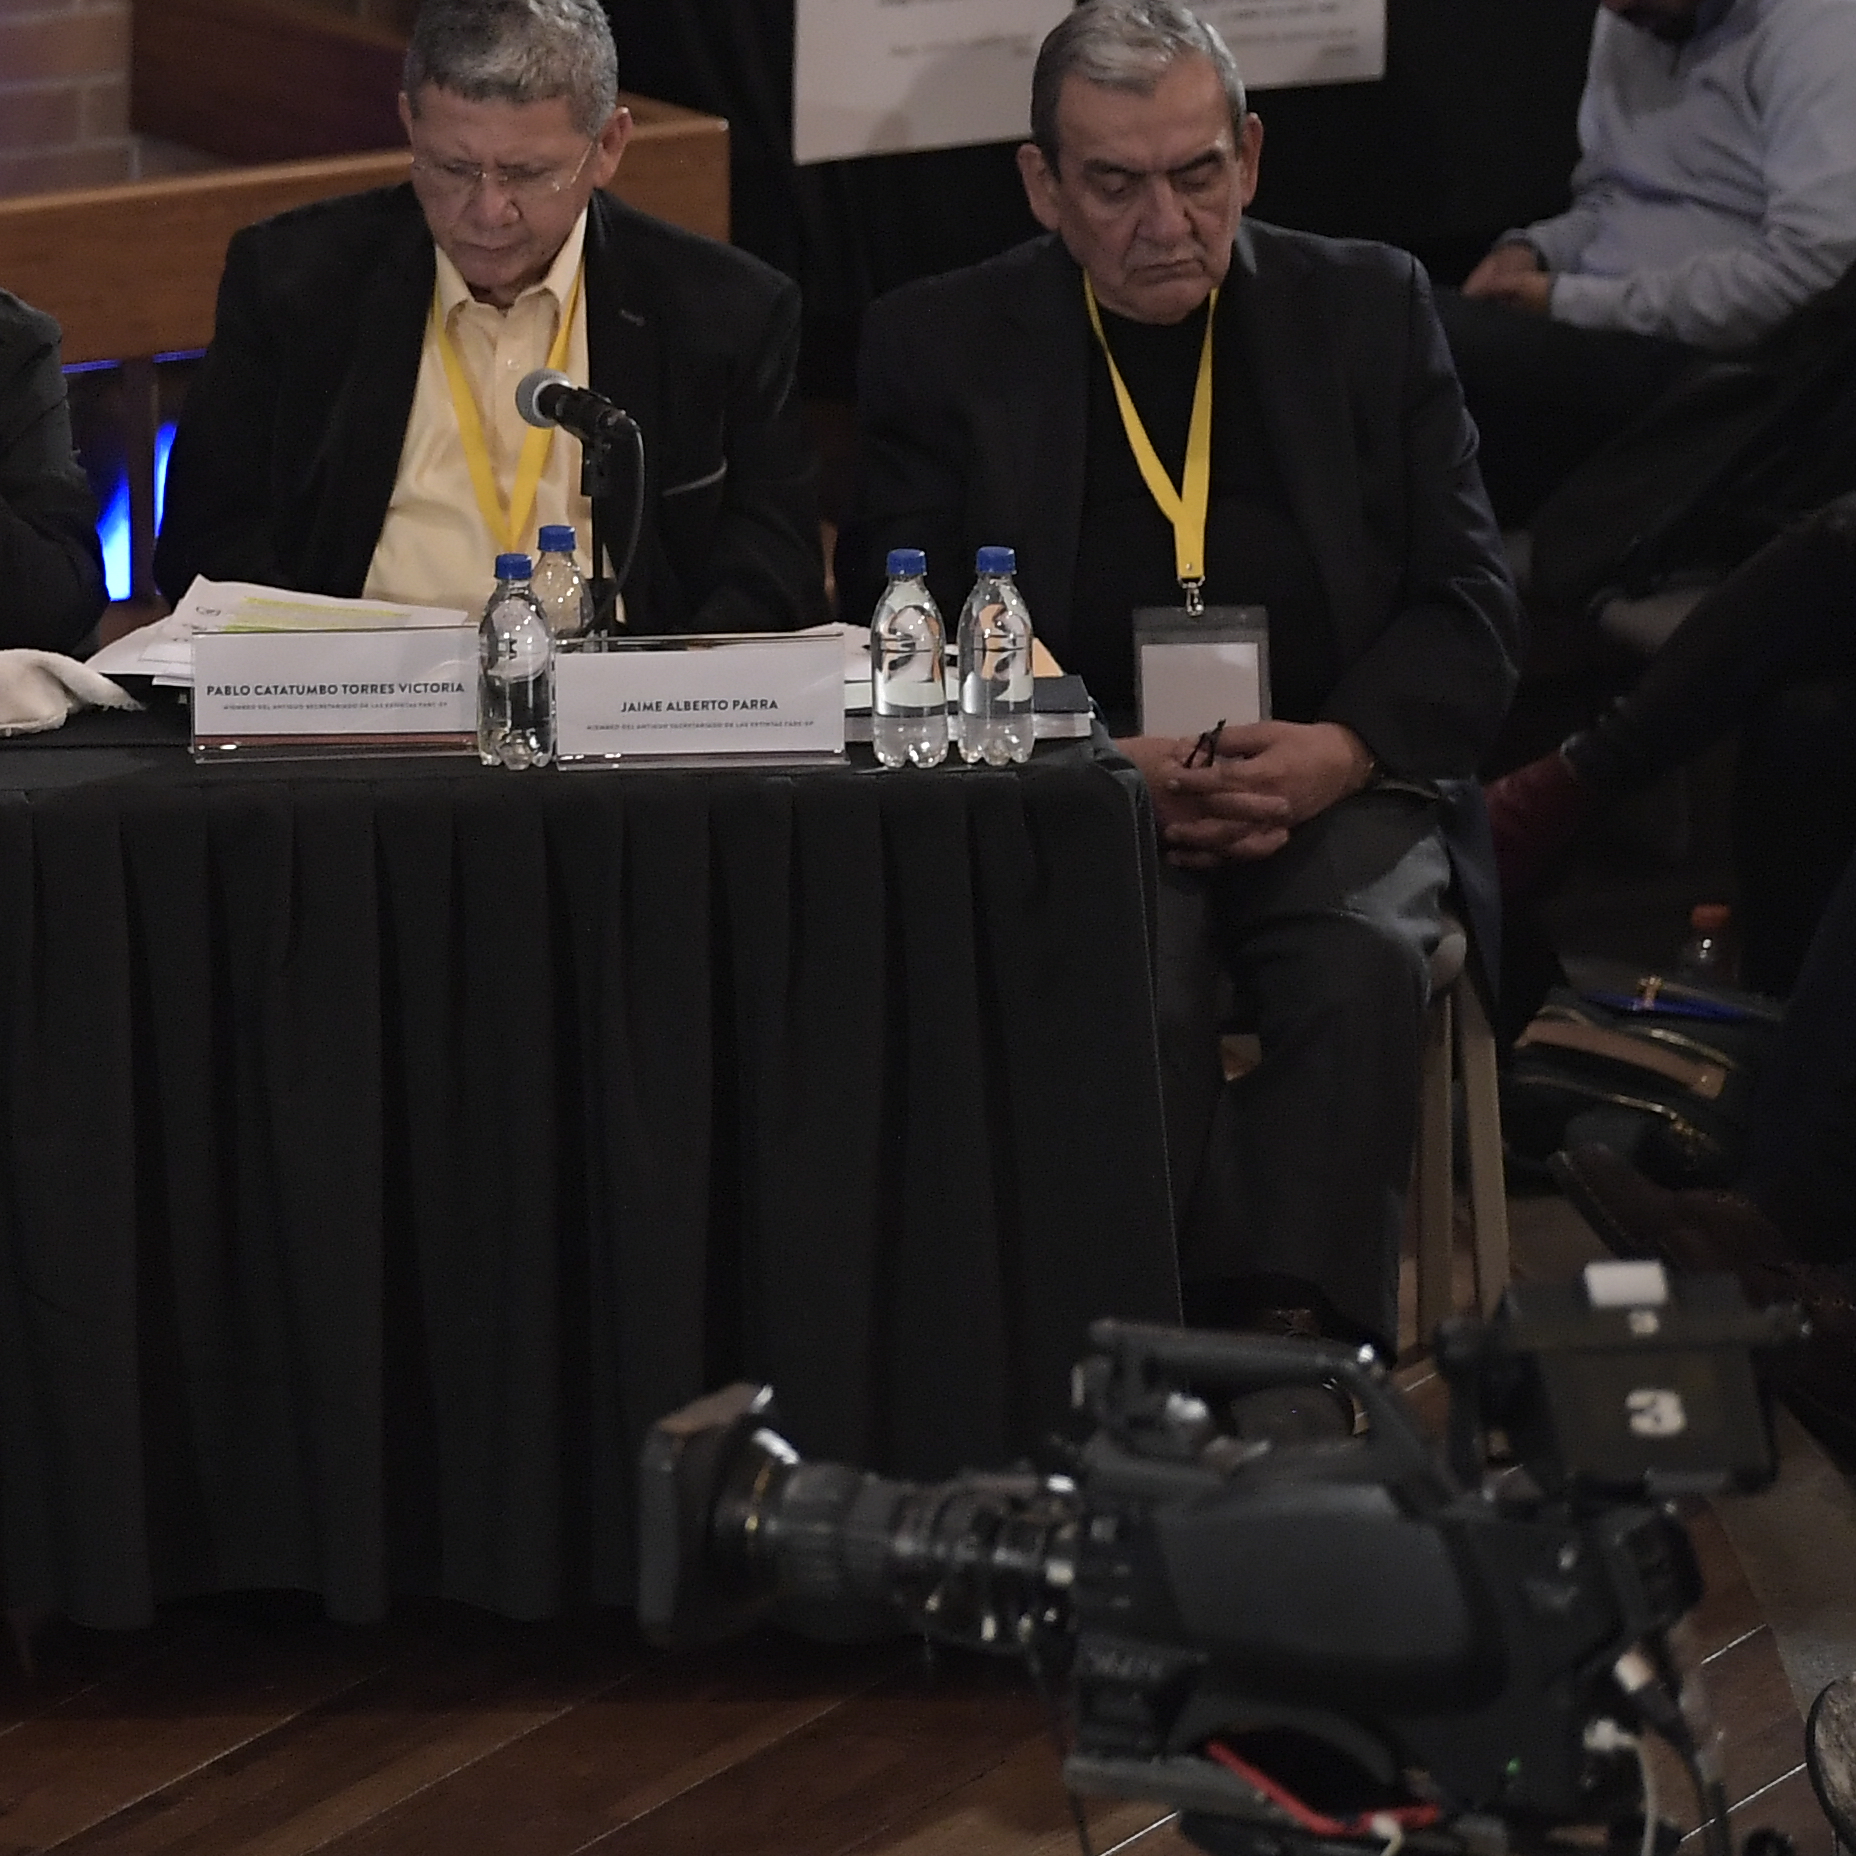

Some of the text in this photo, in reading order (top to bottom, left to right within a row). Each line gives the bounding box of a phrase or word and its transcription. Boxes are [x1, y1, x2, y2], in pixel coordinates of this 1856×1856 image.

[206, 682, 465, 696] PABLO CATATUMBO TORRES VICTORIA
[620, 698, 778, 712] JAIME ALBERTO PARRA
[1625, 1388, 1687, 1437] 3
